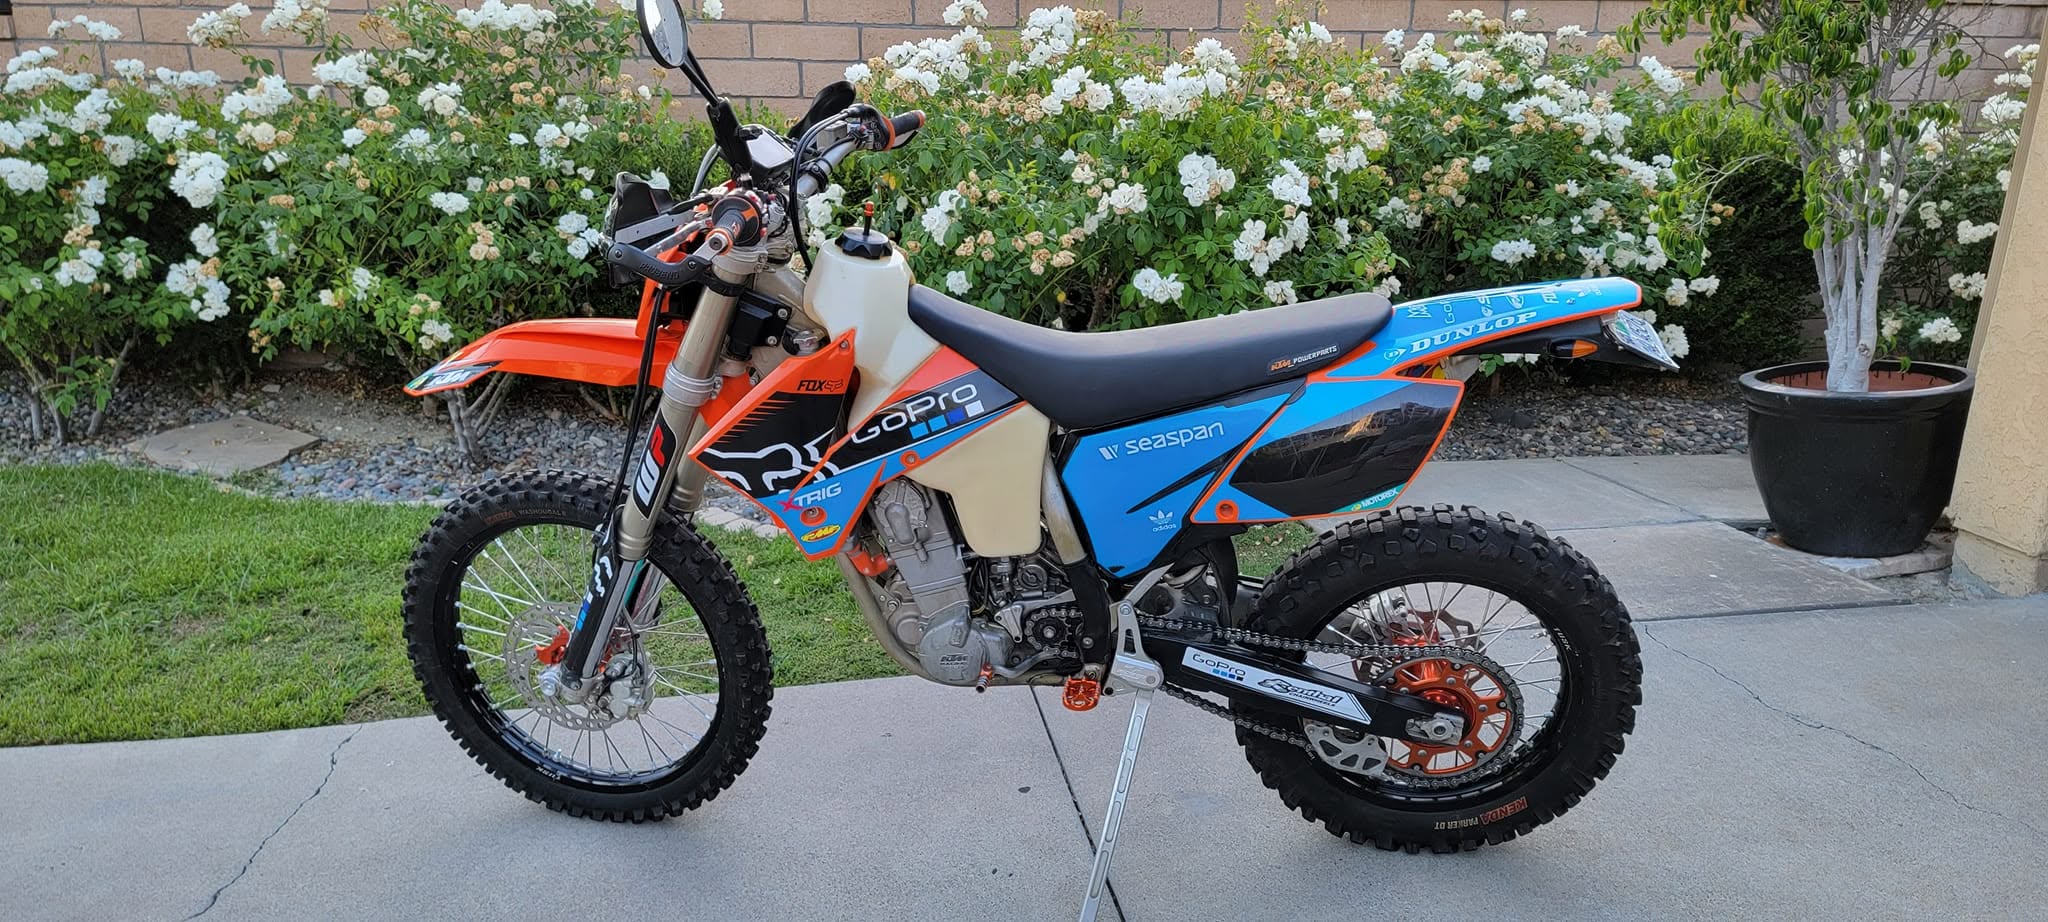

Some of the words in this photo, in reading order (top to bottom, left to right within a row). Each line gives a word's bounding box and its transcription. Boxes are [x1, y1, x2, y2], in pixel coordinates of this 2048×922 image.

[1410, 312, 1537, 354] DUNLOP
[1271, 359, 1292, 371] KTM
[1293, 345, 1337, 364] POWERPARTS
[797, 380, 824, 392] FOX
[850, 384, 978, 444] GoPro
[1125, 422, 1224, 455] seaspan
[1361, 488, 1399, 508] MOTOREX
[1152, 523, 1177, 532] adidas
[1193, 653, 1246, 677] GoPro
[1480, 796, 1528, 825] KENDA
[1434, 821, 1446, 830] DT
[1447, 817, 1479, 829] PARKER
